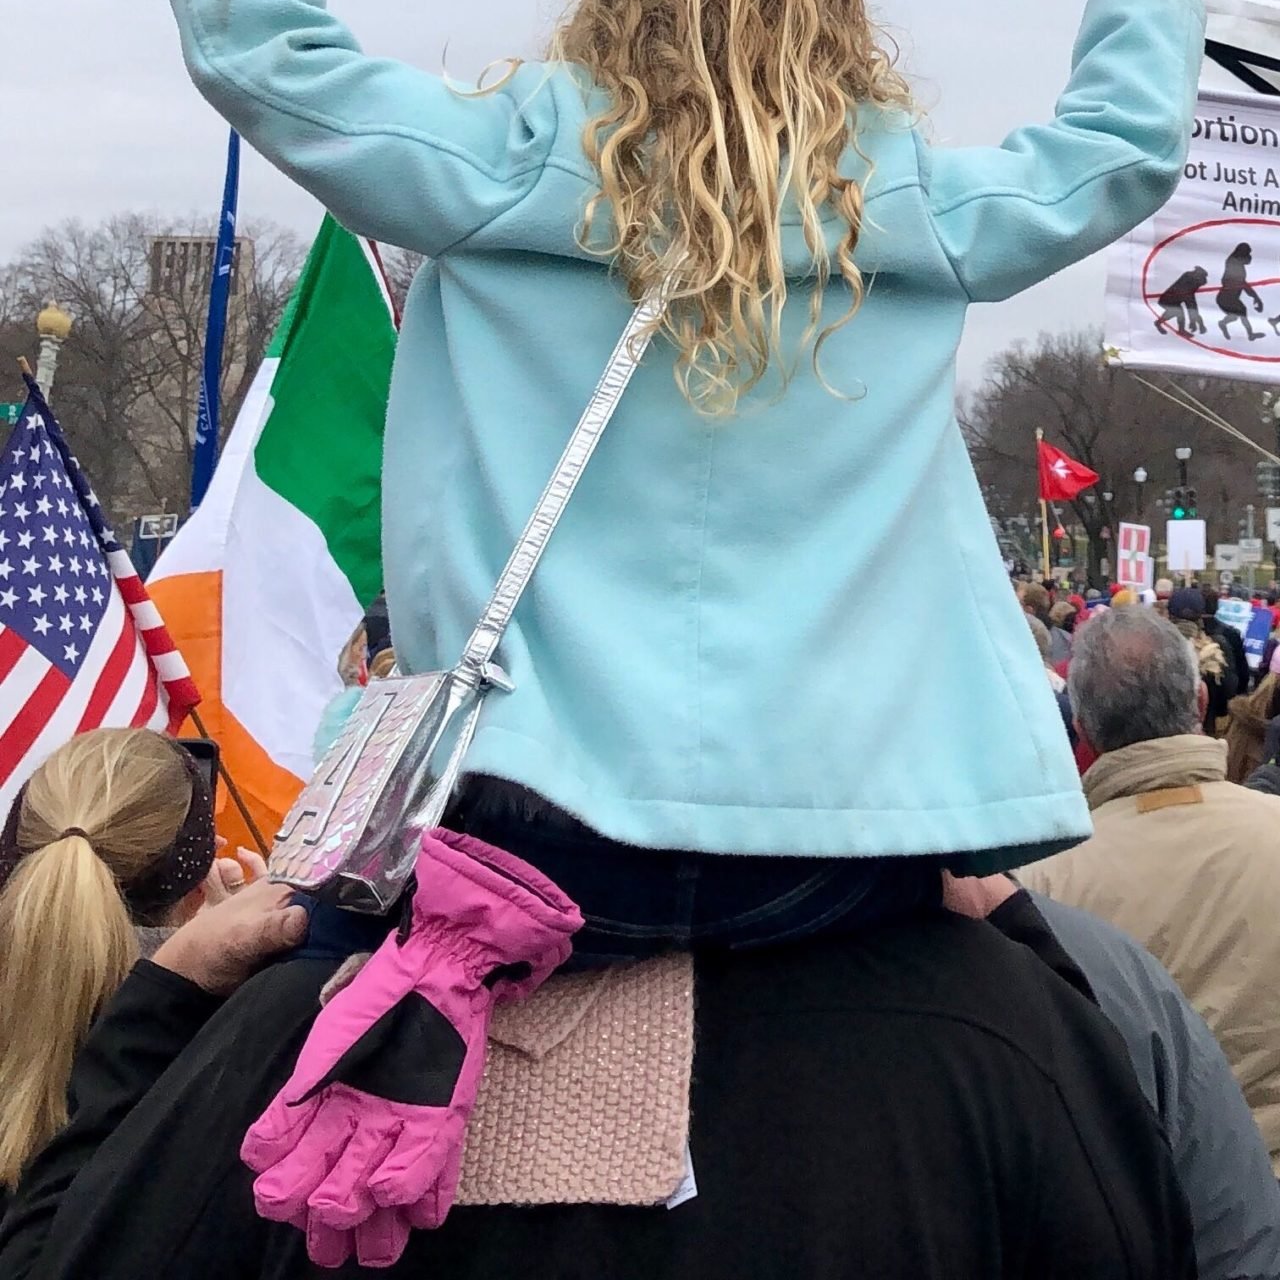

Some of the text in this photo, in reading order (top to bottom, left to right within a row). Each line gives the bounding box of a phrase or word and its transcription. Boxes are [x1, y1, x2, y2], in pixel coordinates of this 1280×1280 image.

[1192, 115, 1279, 148] ortion
[1184, 161, 1208, 181] ot
[1213, 162, 1257, 186] Just
